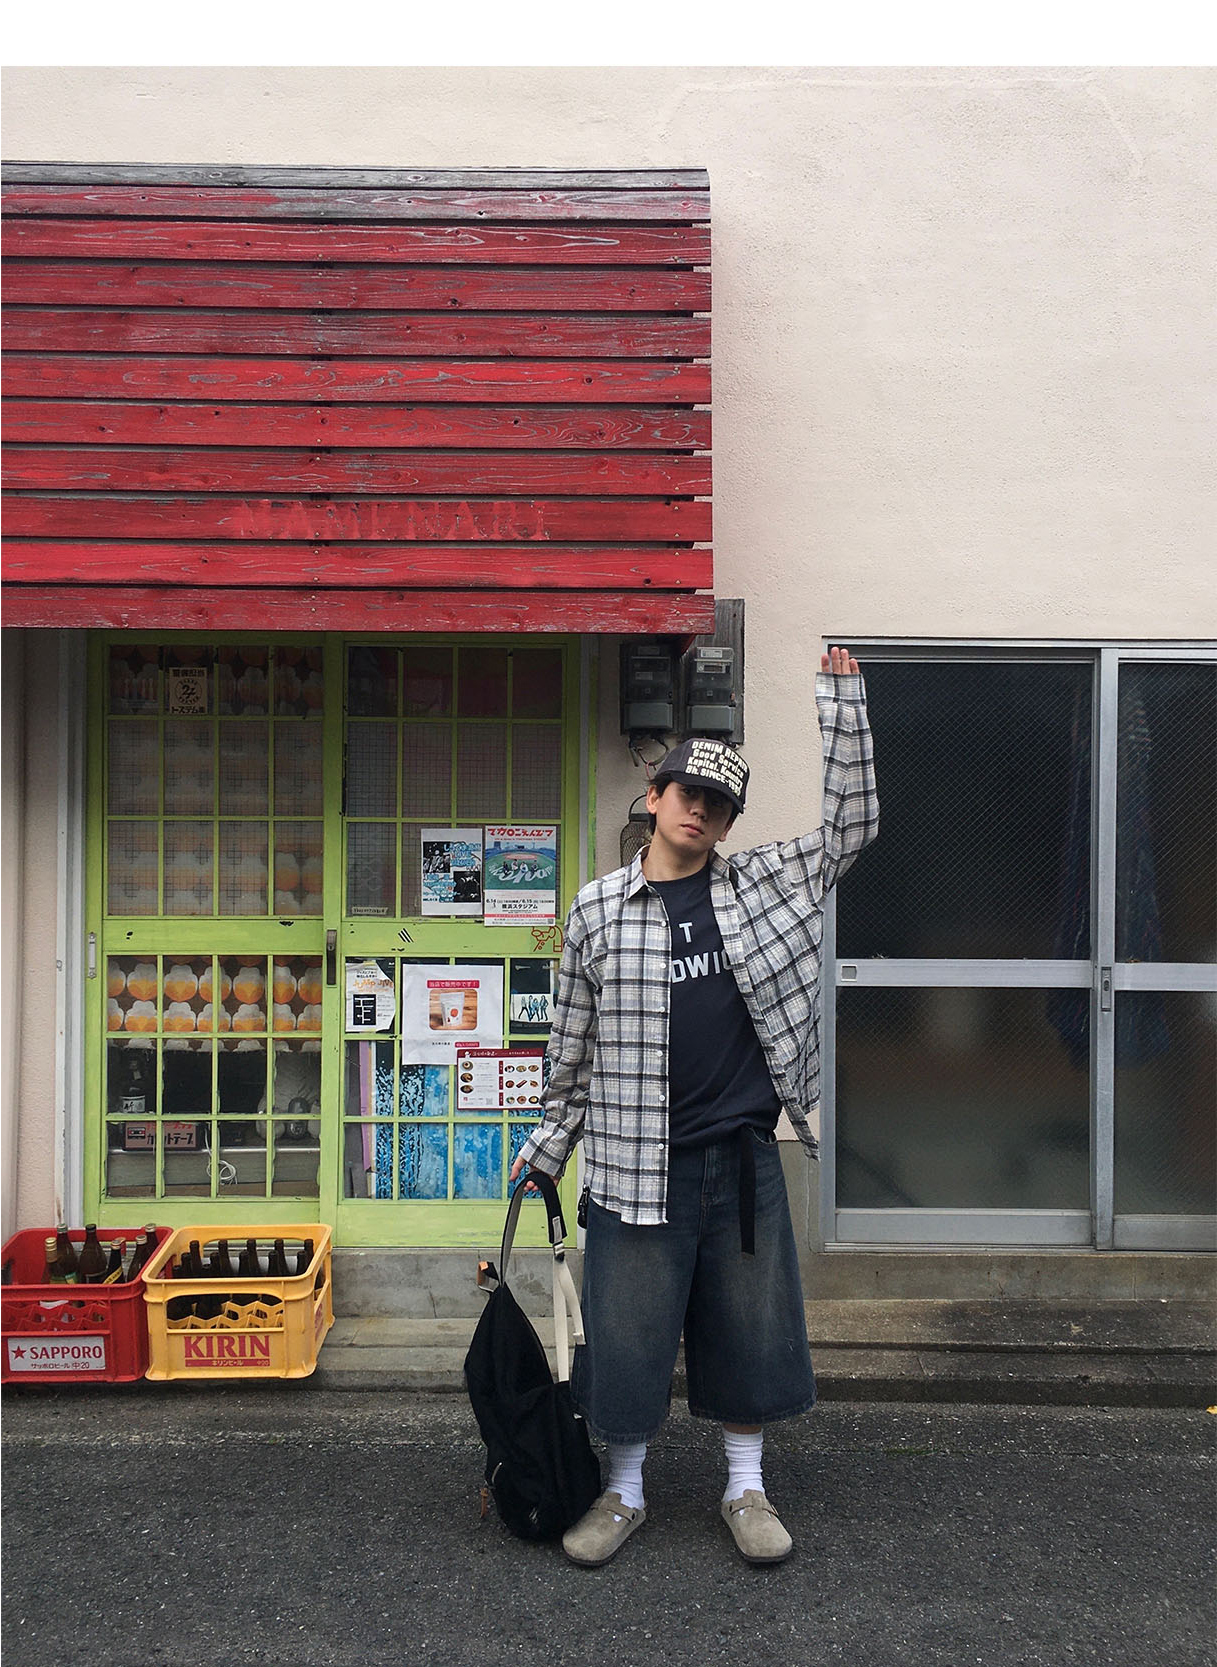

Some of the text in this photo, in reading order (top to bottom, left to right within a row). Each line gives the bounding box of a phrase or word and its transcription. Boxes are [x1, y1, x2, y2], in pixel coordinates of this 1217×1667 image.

[692, 741, 723, 754] DENIM
[693, 749, 716, 760] Good
[30, 1346, 103, 1360] SAPPORO
[184, 1335, 270, 1358] KIRIN
